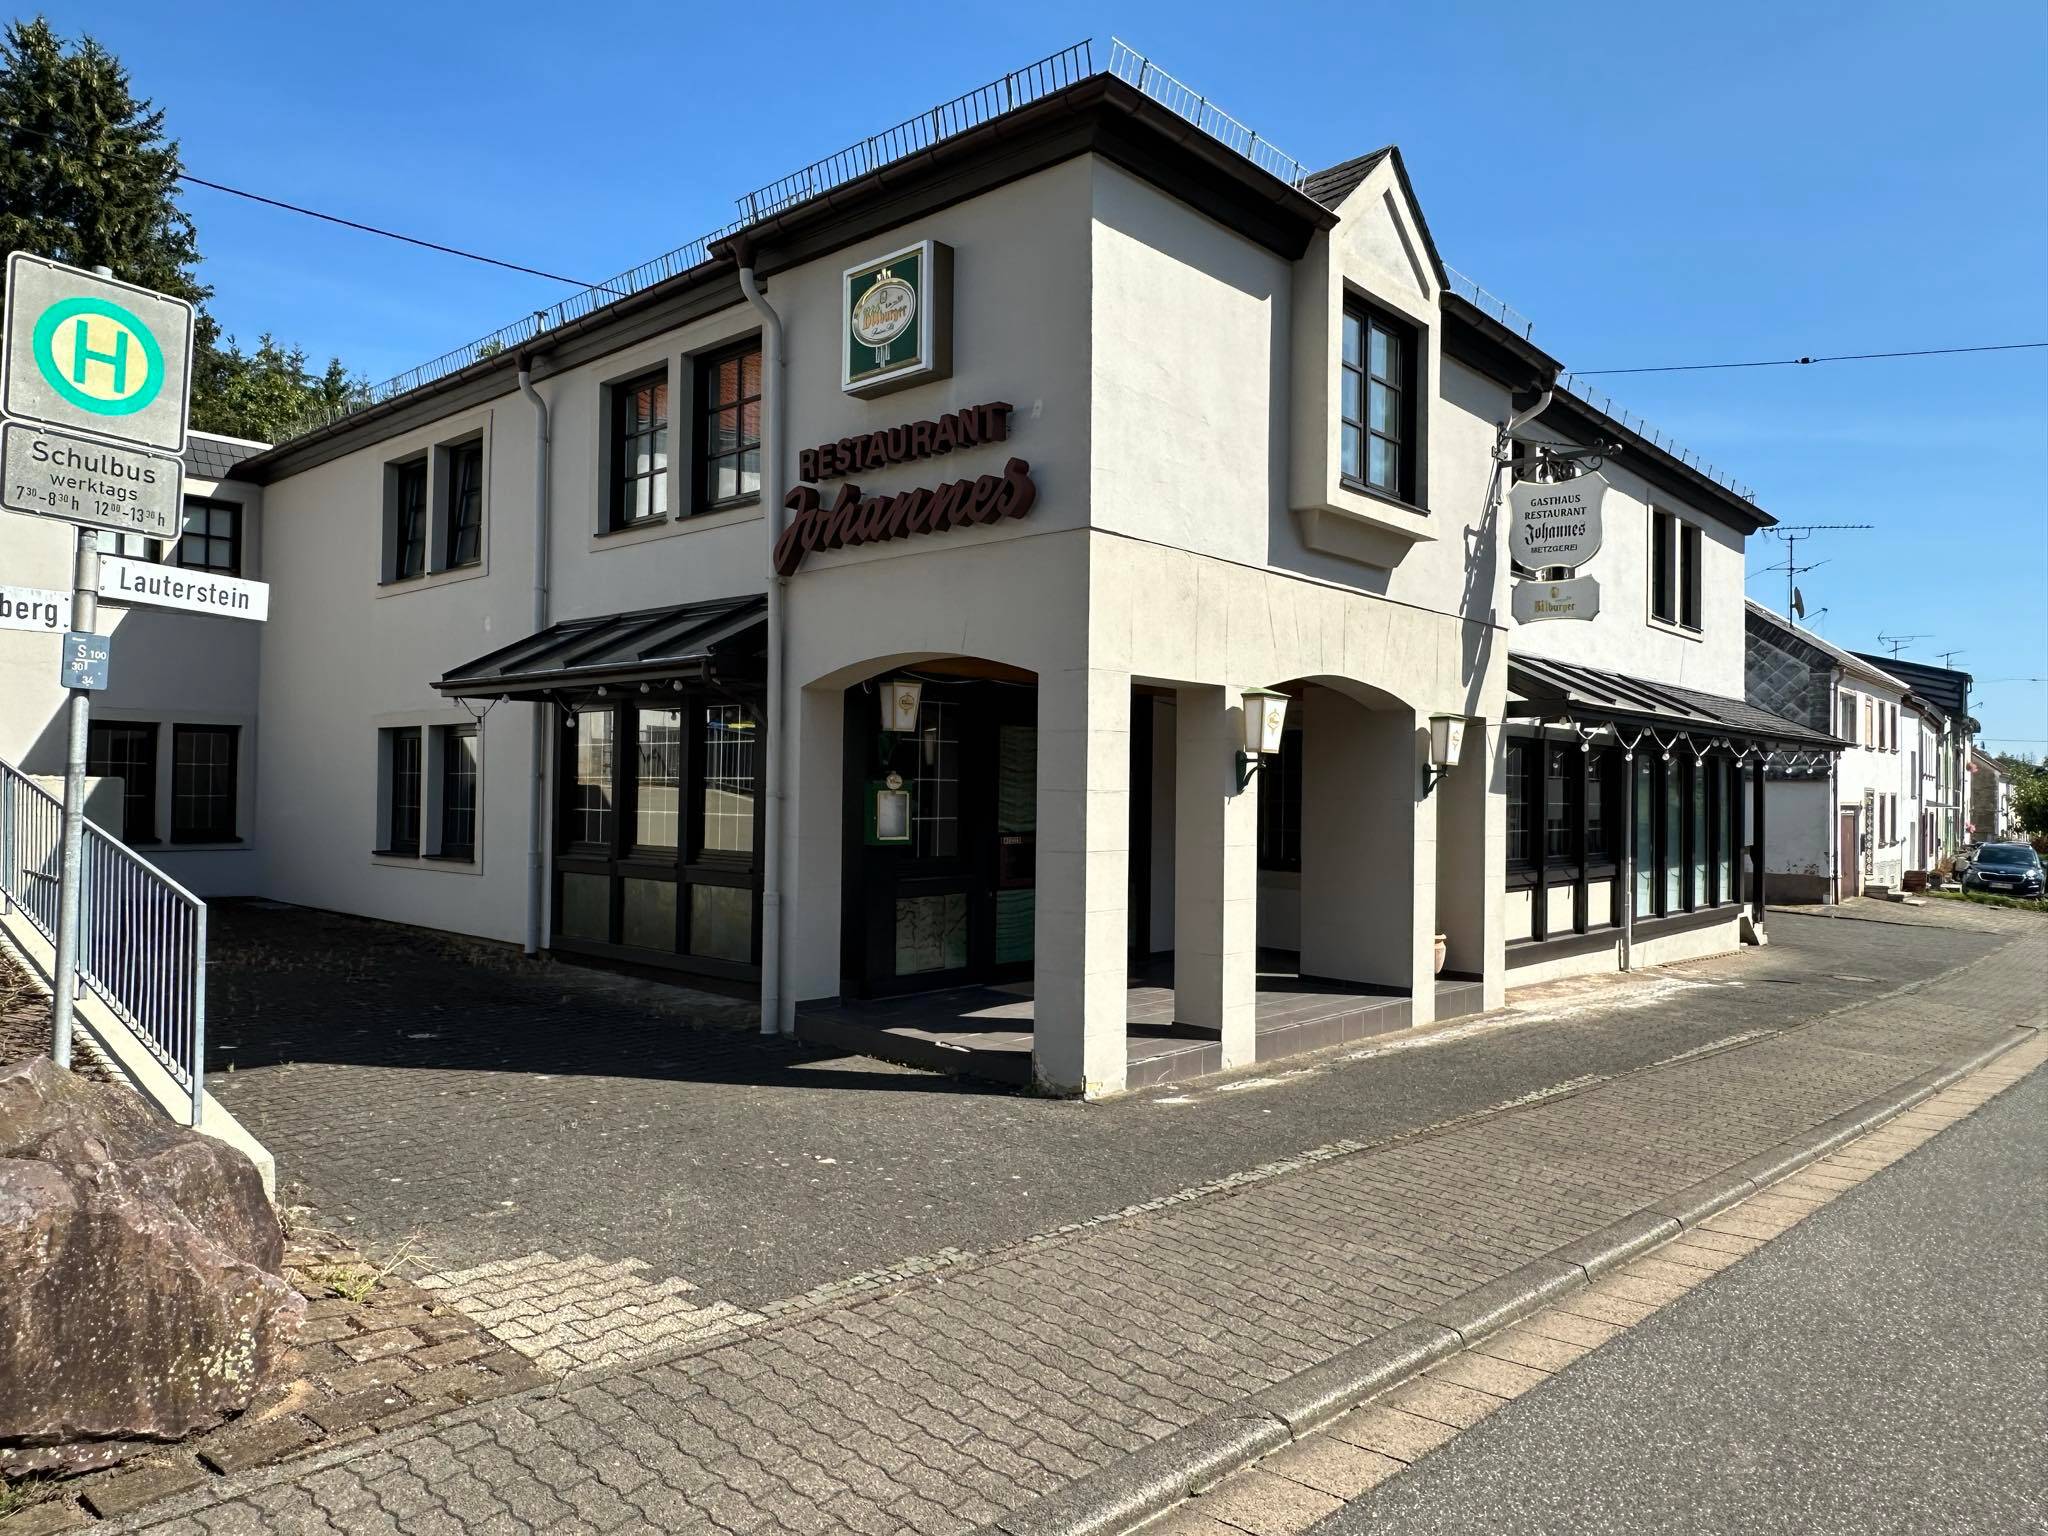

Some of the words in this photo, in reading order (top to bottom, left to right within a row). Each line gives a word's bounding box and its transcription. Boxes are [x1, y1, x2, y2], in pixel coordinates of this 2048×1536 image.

[73, 319, 128, 394] H
[800, 401, 1013, 483] RESTAURANT
[32, 440, 156, 484] Schulbus
[50, 473, 138, 502] werktags
[1530, 494, 1581, 507] GASTHAUS
[773, 457, 1036, 577] Johannes
[1524, 506, 1587, 520] RESTAURANT
[1524, 521, 1586, 545] Johannes
[1531, 543, 1578, 554] METZGEREI
[120, 566, 249, 610] Lauterstein
[77, 644, 87, 658] S
[90, 650, 107, 660] 100
